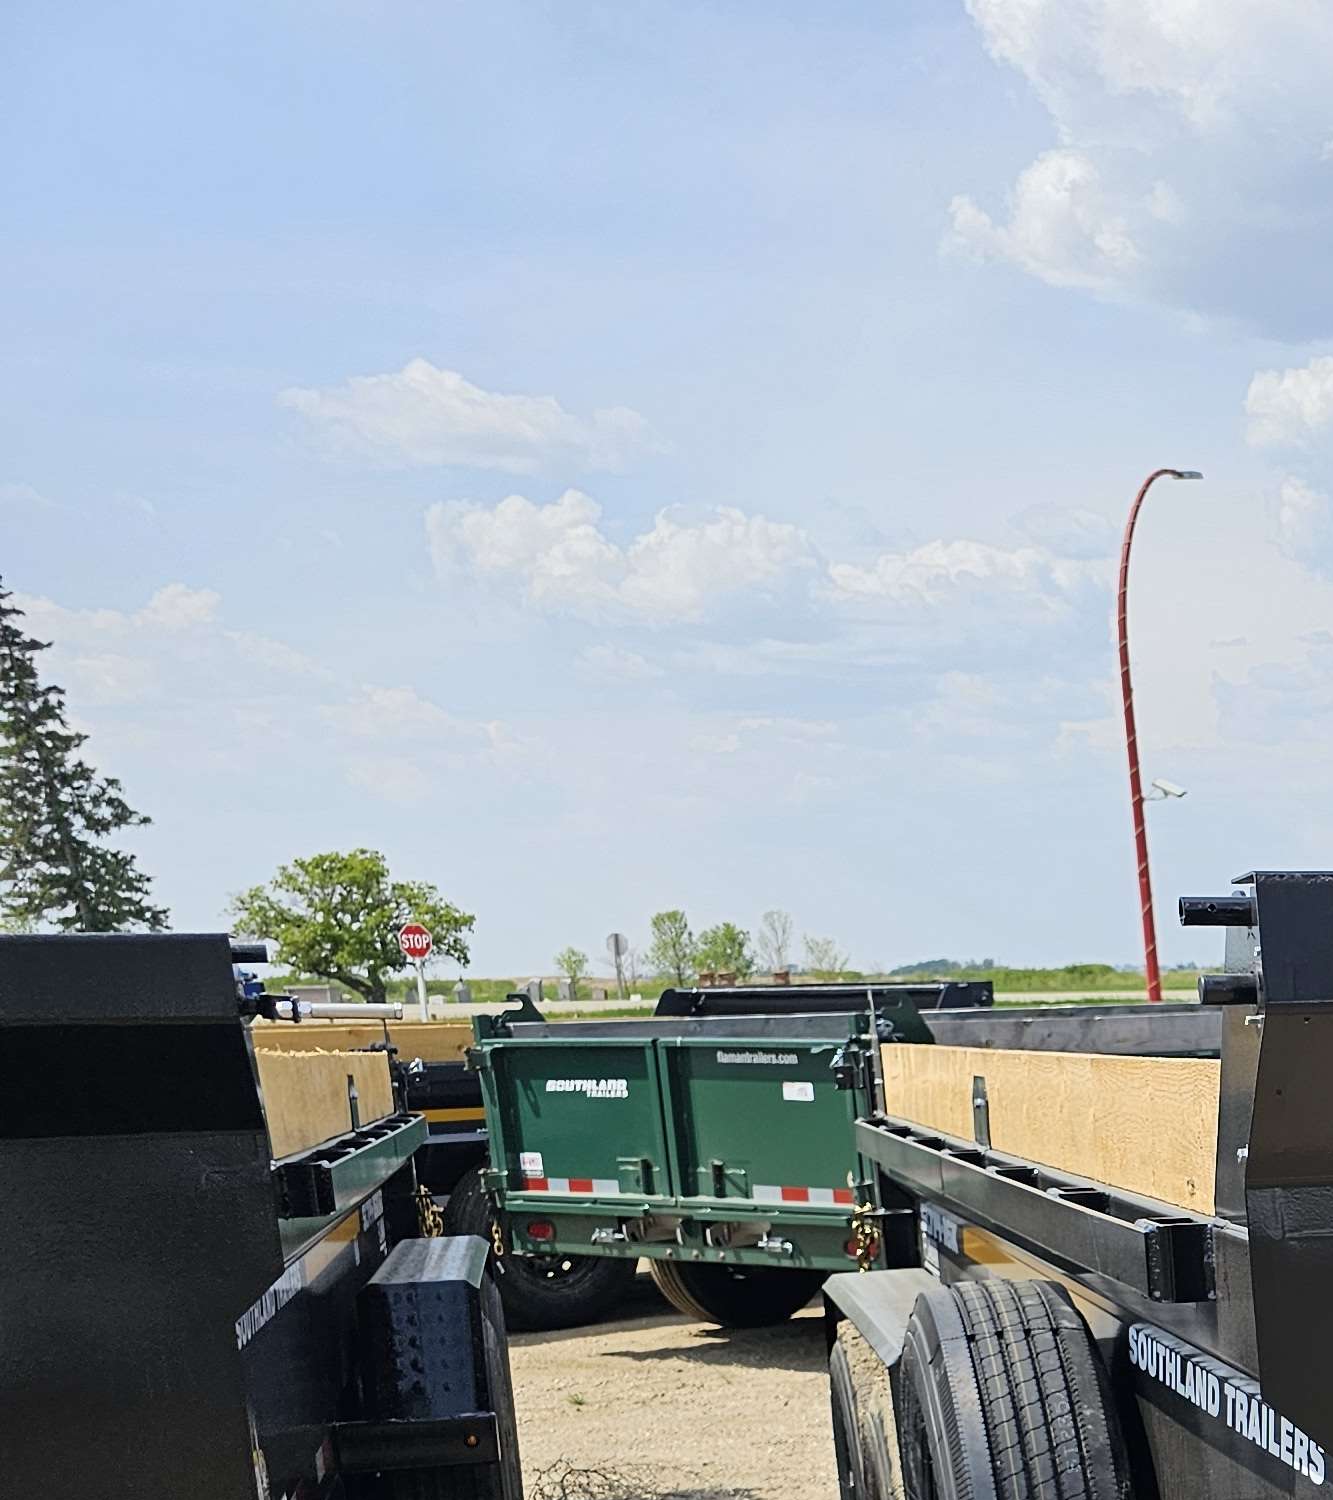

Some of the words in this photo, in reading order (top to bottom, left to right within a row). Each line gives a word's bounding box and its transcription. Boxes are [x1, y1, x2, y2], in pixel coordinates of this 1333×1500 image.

[401, 933, 430, 949] STOP
[1128, 1325, 1220, 1418] SOUTHLAND
[1223, 1382, 1325, 1486] TRAILERS
